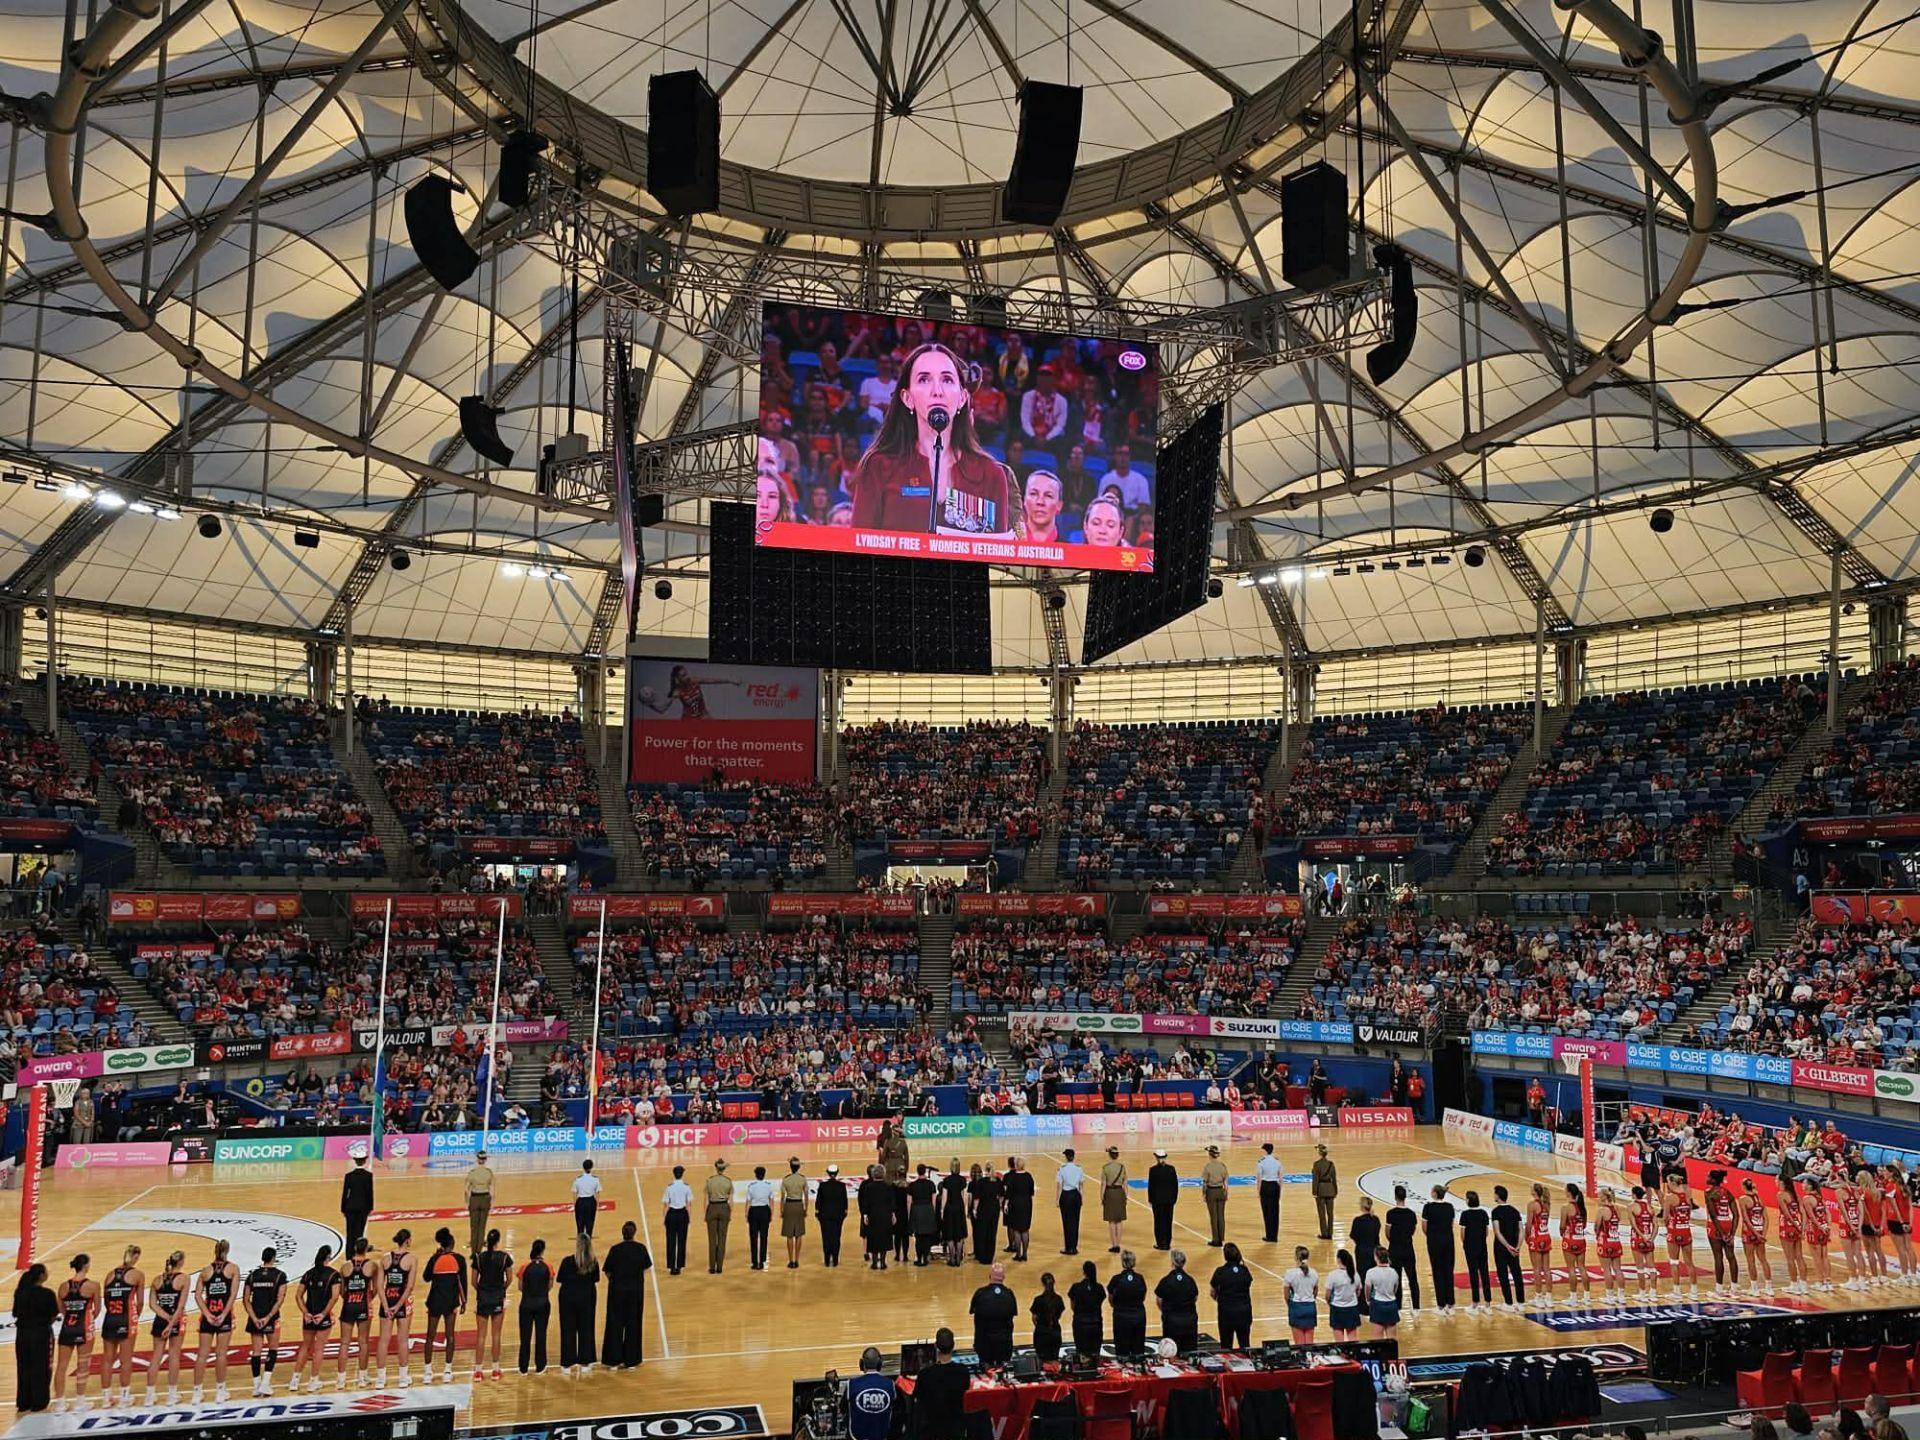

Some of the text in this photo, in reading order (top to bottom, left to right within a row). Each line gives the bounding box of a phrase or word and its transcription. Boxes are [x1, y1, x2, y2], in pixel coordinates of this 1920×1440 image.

[1124, 355, 1141, 365] FOX
[855, 533, 897, 549] LYNDSAY
[898, 538, 920, 551] FREE
[929, 539, 970, 554] WOMENS
[972, 543, 1015, 557] VETERANS
[1017, 545, 1064, 560] AUSTRALIA
[747, 683, 778, 698] red
[753, 699, 785, 709] energy
[645, 736, 804, 752] Power for the moments
[685, 754, 715, 766] that
[1792, 848, 1809, 867] A3
[882, 898, 912, 906] WE FLY
[141, 950, 161, 959] GINA
[506, 1026, 540, 1034] aware
[1153, 1018, 1185, 1027] aware
[1228, 1023, 1277, 1034] SUZUKI
[1291, 1023, 1351, 1034] QBE QBE
[381, 1032, 426, 1046] VALOUR
[1282, 1032, 1312, 1040] Insurance
[1375, 1030, 1418, 1042] VALOUR
[226, 1043, 262, 1053] PRINTHIE
[274, 1037, 330, 1050] red red
[1485, 1034, 1596, 1053] QBE QBE aware
[157, 1051, 190, 1061] Specsavers
[1475, 1045, 1550, 1056] Insurance Insurance
[34, 1061, 73, 1074] aware
[109, 1056, 145, 1068] Specsavers
[1638, 1048, 1661, 1059] QBE
[1682, 1051, 1707, 1063] QBE
[1723, 1055, 1748, 1068] QBE
[1766, 1060, 1789, 1073] QBE
[1809, 1068, 1868, 1087] GILBERT
[1629, 1058, 1790, 1083] Insurance Insurance Insurance Insurance
[1878, 1080, 1911, 1091] Specsavers
[36, 1093, 48, 1147] NISSAN
[1003, 1116, 1070, 1129] QBE QBE
[1157, 1115, 1212, 1126] red red
[1252, 1113, 1304, 1125] GILBERT
[1345, 1113, 1408, 1123] NISSAN
[1446, 1112, 1482, 1129] red red
[817, 1125, 882, 1137] NISSA
[907, 1122, 966, 1135] SUNCORP
[1503, 1125, 1549, 1143] QBE QBE
[447, 1128, 626, 1147] QBE QBE QBE QBE
[663, 1129, 708, 1145] HCF
[219, 1145, 292, 1160] SUNCORP
[534, 1143, 575, 1152] Insurance
[1559, 1139, 1605, 1158] red ed
[31, 1151, 43, 1205] NISSAN
[108, 1300, 124, 1314] GS
[208, 1299, 223, 1312] GA
[1547, 1310, 1702, 1327] Tyrepower
[107, 1335, 449, 1371] NSSAN
[863, 1393, 885, 1404] FOX
[78, 1401, 334, 1430] SUZUKI
[554, 1413, 735, 1439] CODE
